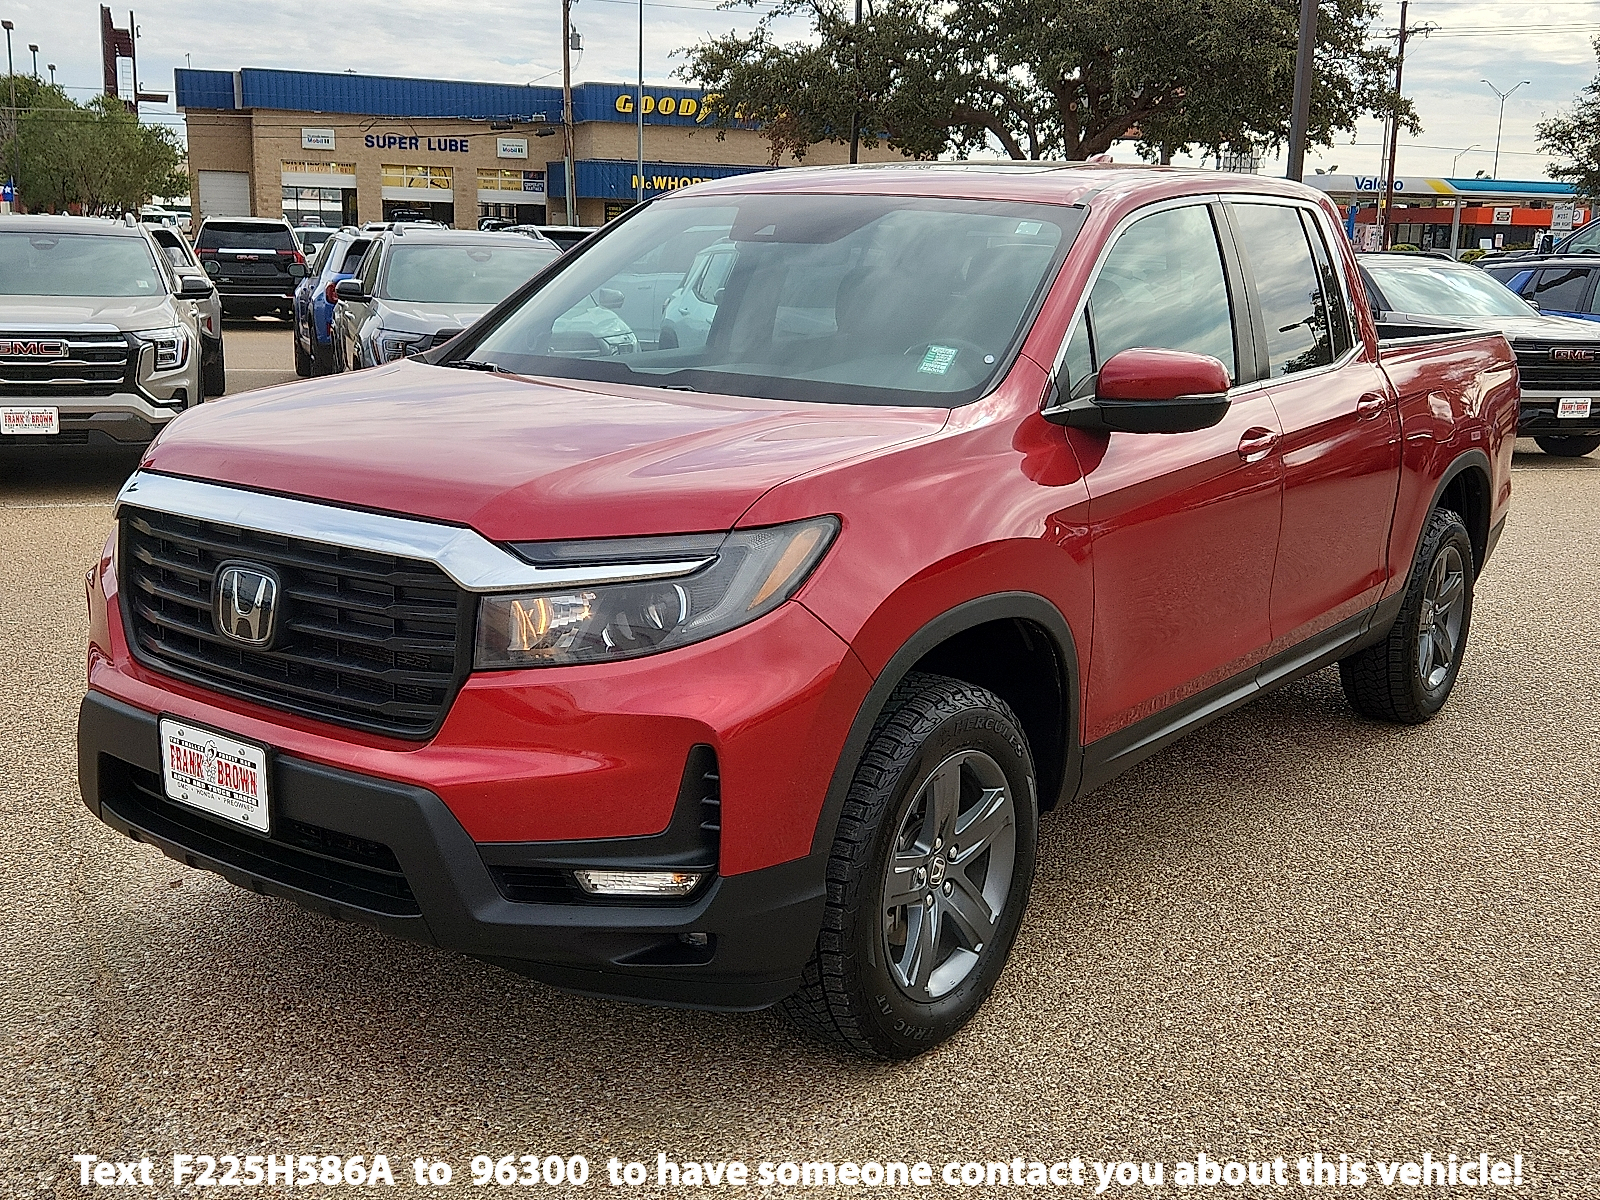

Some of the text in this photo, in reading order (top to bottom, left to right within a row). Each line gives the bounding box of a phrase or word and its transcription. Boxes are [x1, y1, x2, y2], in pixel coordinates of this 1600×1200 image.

[364, 134, 469, 153] SUPER LUBE
[1354, 176, 1404, 190] Valeo
[1554, 349, 1595, 361] GMC
[4, 414, 54, 424] FRANK BROWN
[954, 714, 1025, 758] HERCULES
[169, 743, 258, 797] FRANK BROWN
[223, 797, 255, 813] PREOWNED
